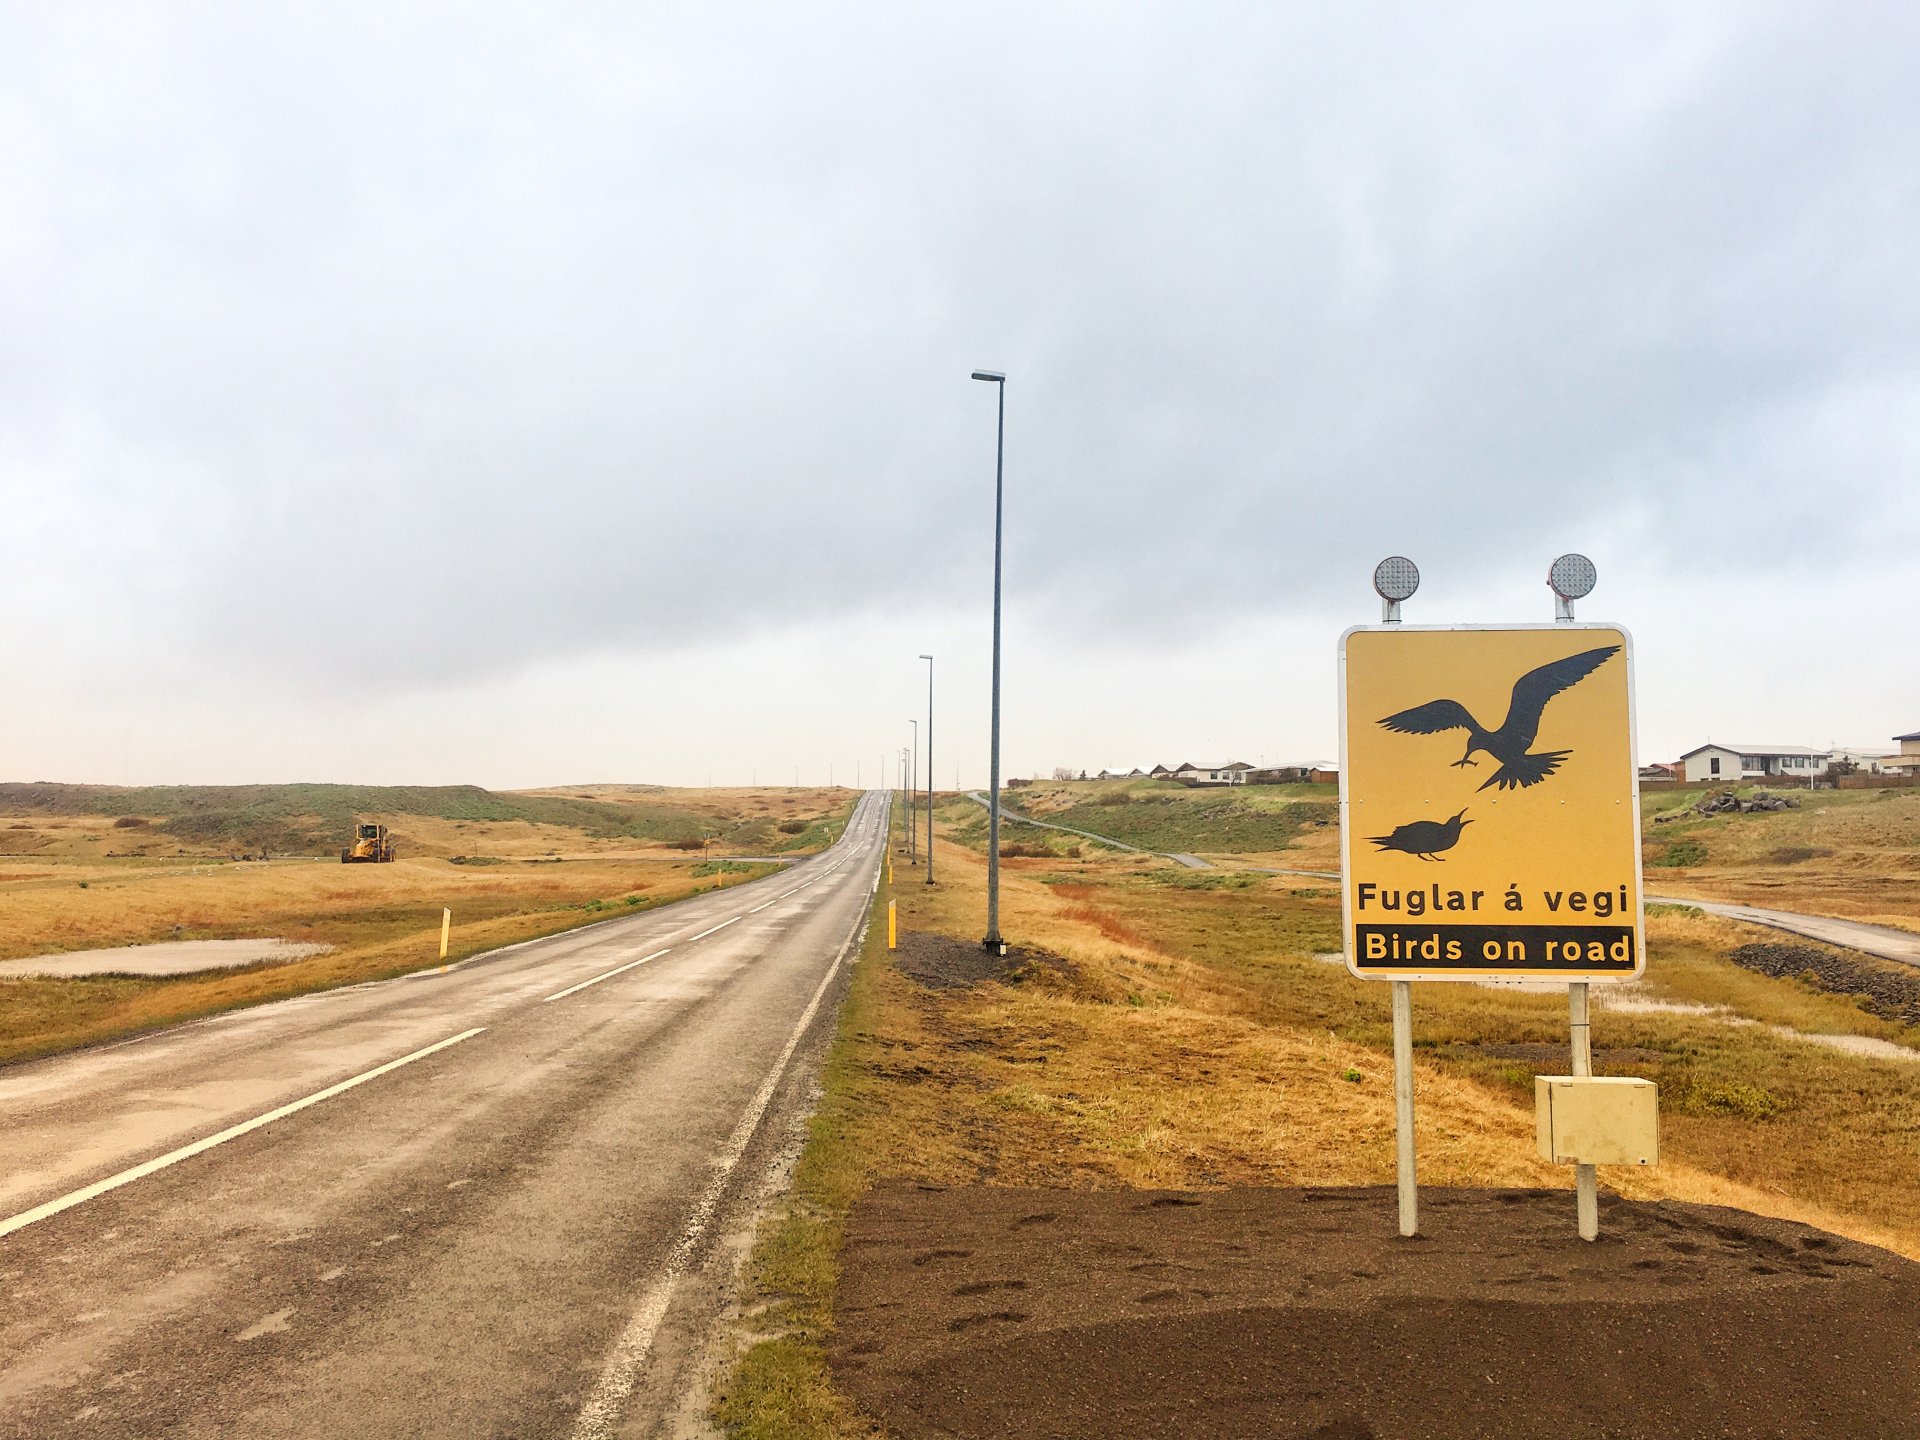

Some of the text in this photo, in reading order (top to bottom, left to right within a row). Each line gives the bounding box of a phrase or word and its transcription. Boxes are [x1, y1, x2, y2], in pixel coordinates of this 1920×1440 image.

[1358, 883, 1628, 918] Fuglar á vegi
[1365, 933, 1630, 962] Birds on road
